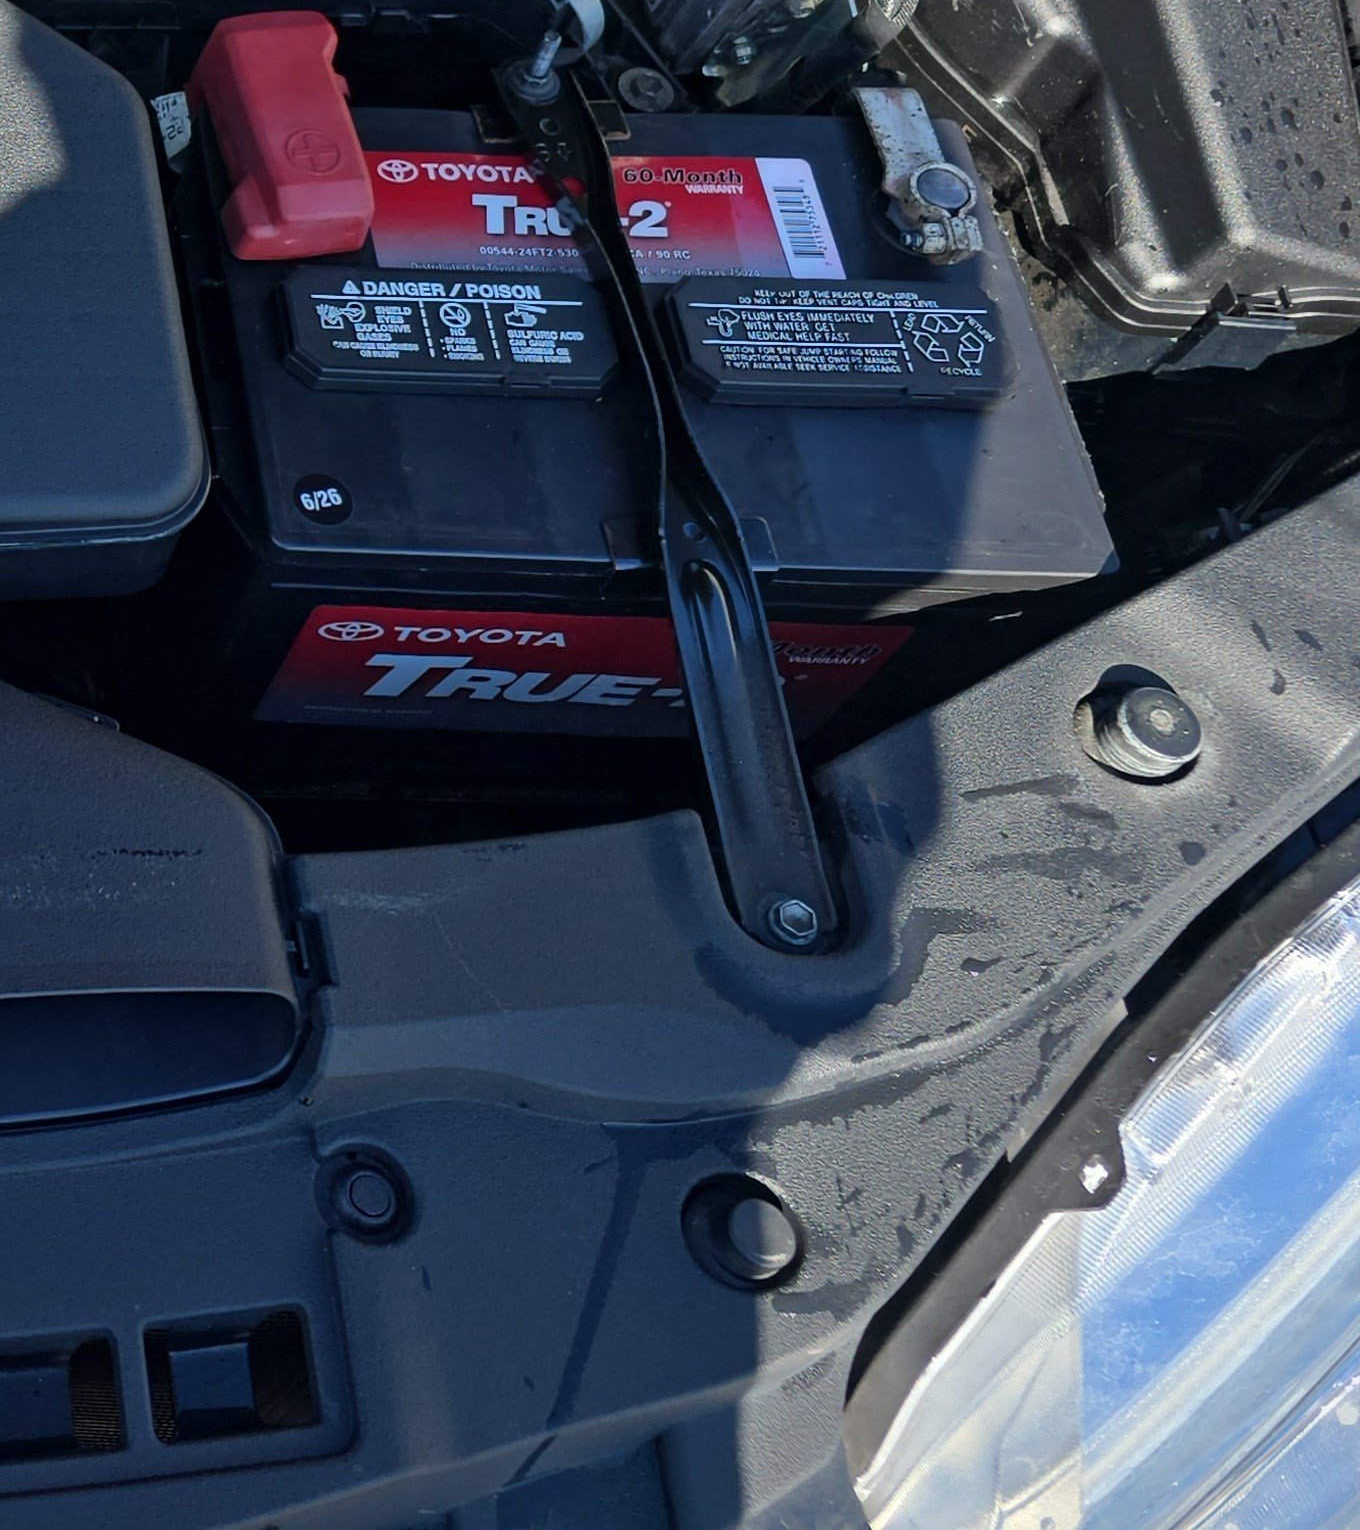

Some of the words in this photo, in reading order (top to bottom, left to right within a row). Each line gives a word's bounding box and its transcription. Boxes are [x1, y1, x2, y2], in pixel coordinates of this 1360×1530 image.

[420, 163, 534, 183] TOYOTA
[623, 168, 743, 185] 60-Month
[685, 184, 744, 194] WARRANTY
[472, 193, 670, 238] TRU-2
[479, 246, 580, 257] 00544-24FT2-530
[656, 250, 671, 259] 90
[674, 251, 692, 259] RC
[362, 281, 446, 296] DANGER
[449, 283, 462, 297] /
[465, 284, 541, 299] POISON
[799, 290, 811, 298] OF
[832, 291, 861, 299] REACH
[840, 299, 864, 307] CAPS
[374, 306, 412, 315] SHIELD
[376, 315, 404, 323] EYES
[741, 311, 774, 321] FLUSH
[776, 312, 805, 322] EYES
[807, 313, 875, 323] IMMEDIATELY
[902, 313, 917, 331] LEAD
[354, 323, 411, 333] EXPLOSIVE
[449, 328, 466, 336] NO
[744, 322, 771, 331] WITH
[773, 322, 810, 331] WATER
[814, 323, 835, 332] GET
[964, 315, 996, 343] RETURN
[356, 333, 392, 341] GASES
[507, 330, 558, 340] SULFURIC
[560, 331, 584, 341] ACID
[747, 331, 794, 341] MEDICAL
[795, 332, 823, 342] HELP
[825, 333, 850, 342] FAST
[940, 367, 983, 376] RECYCLE
[301, 487, 342, 510] 6/26
[393, 626, 567, 648] TOYOTA
[789, 656, 870, 665] WARRANTY
